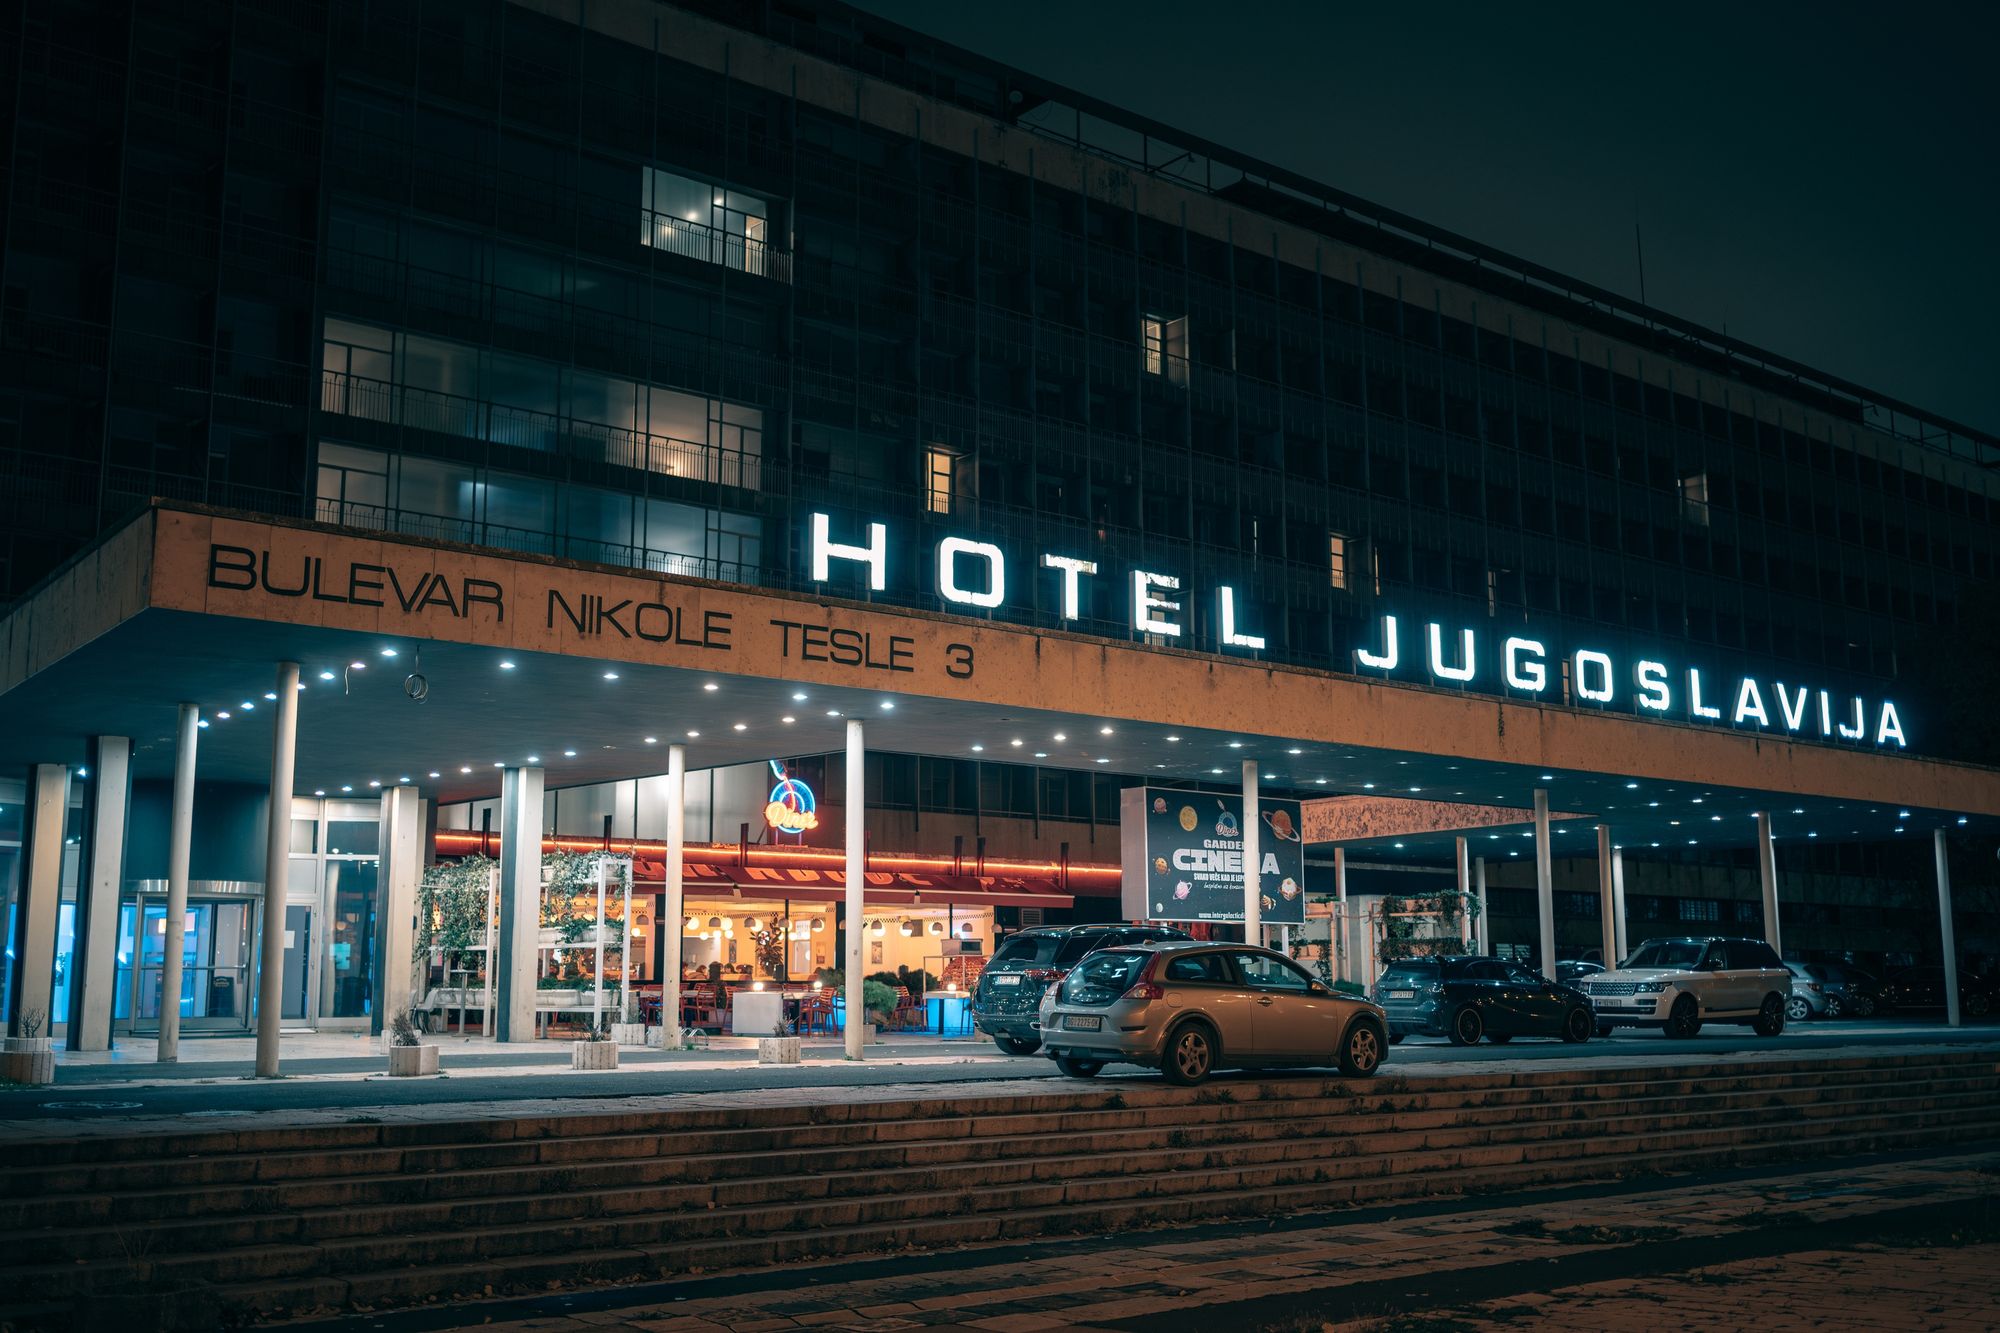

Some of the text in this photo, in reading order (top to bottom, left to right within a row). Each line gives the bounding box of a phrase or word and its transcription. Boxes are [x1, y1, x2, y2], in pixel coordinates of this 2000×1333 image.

[207, 543, 974, 679] BULEVAR NIKOLE TESLE 3
[808, 512, 1907, 746] HOTEL JUGOSLAVIJA
[1172, 848, 1280, 875] CINEA
